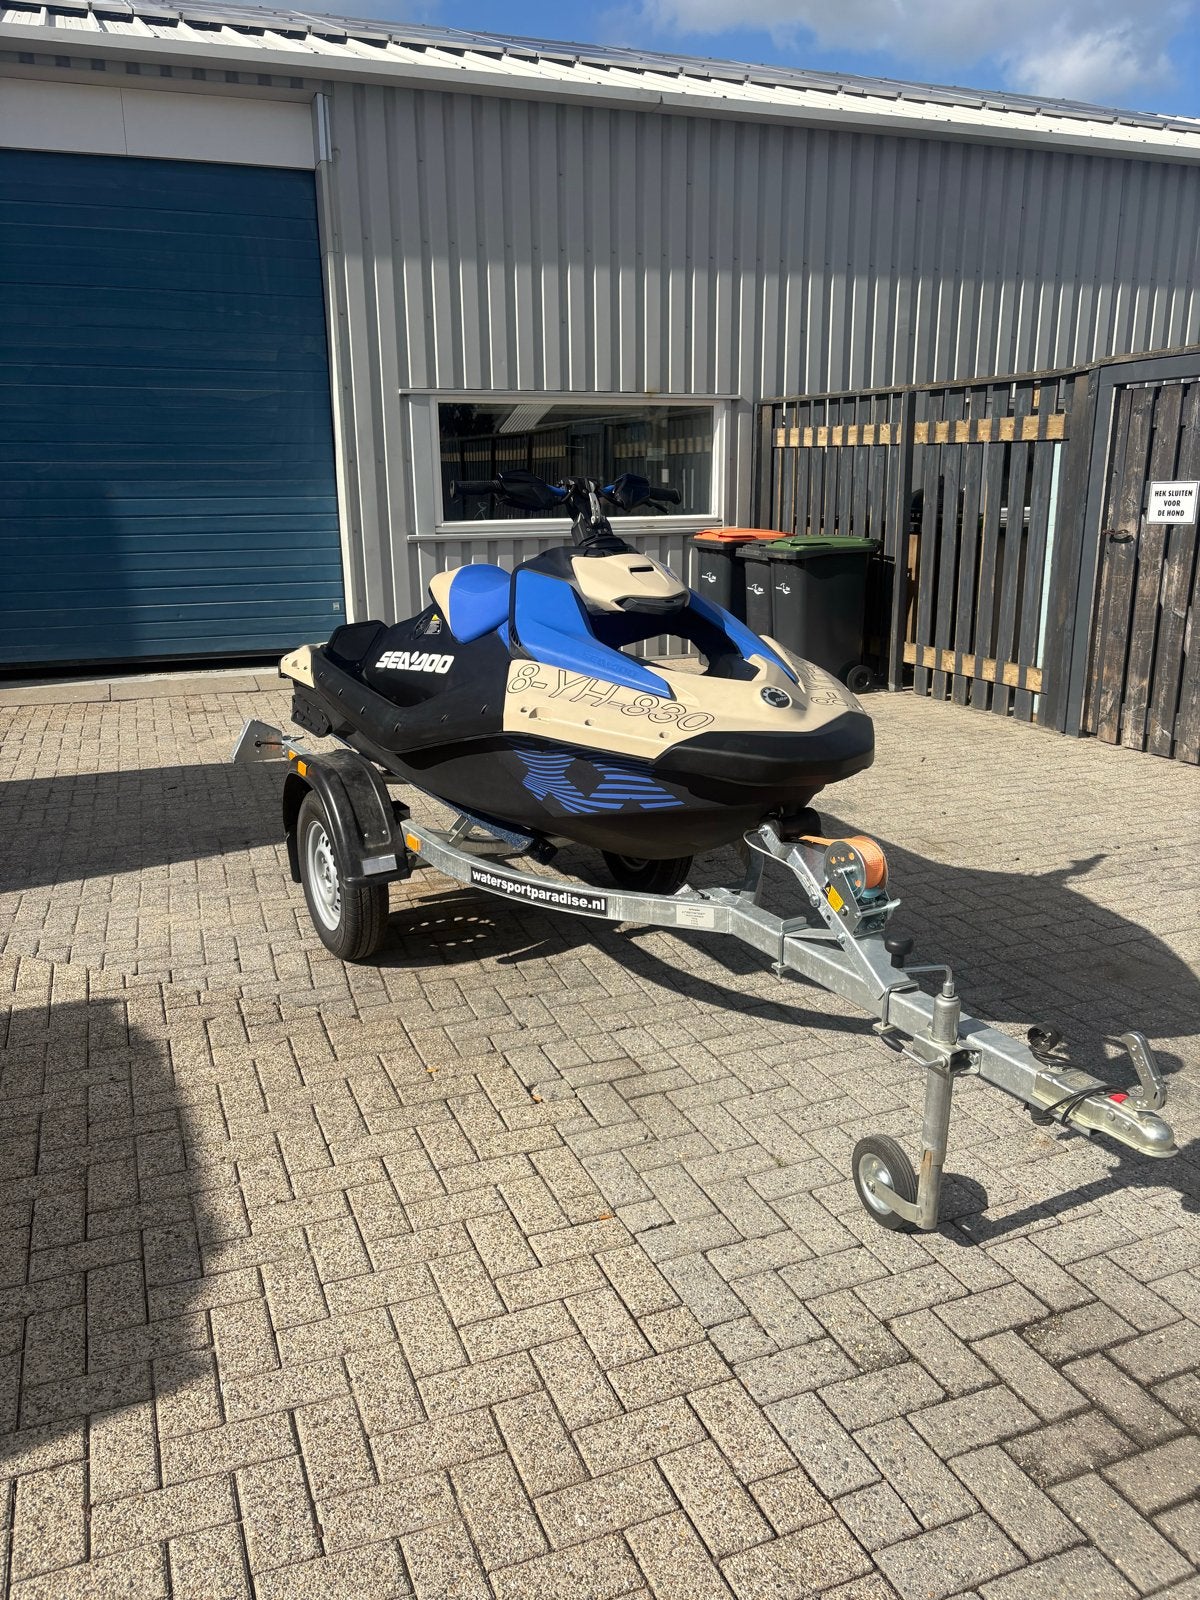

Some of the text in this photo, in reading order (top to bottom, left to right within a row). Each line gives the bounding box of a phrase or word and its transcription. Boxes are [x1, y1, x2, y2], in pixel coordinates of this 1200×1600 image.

[1157, 509, 1185, 517] DE HOND
[1163, 499, 1181, 507] VOOR
[506, 663, 716, 732] 8-YH-830
[471, 870, 606, 911] watersportparadise.nl
